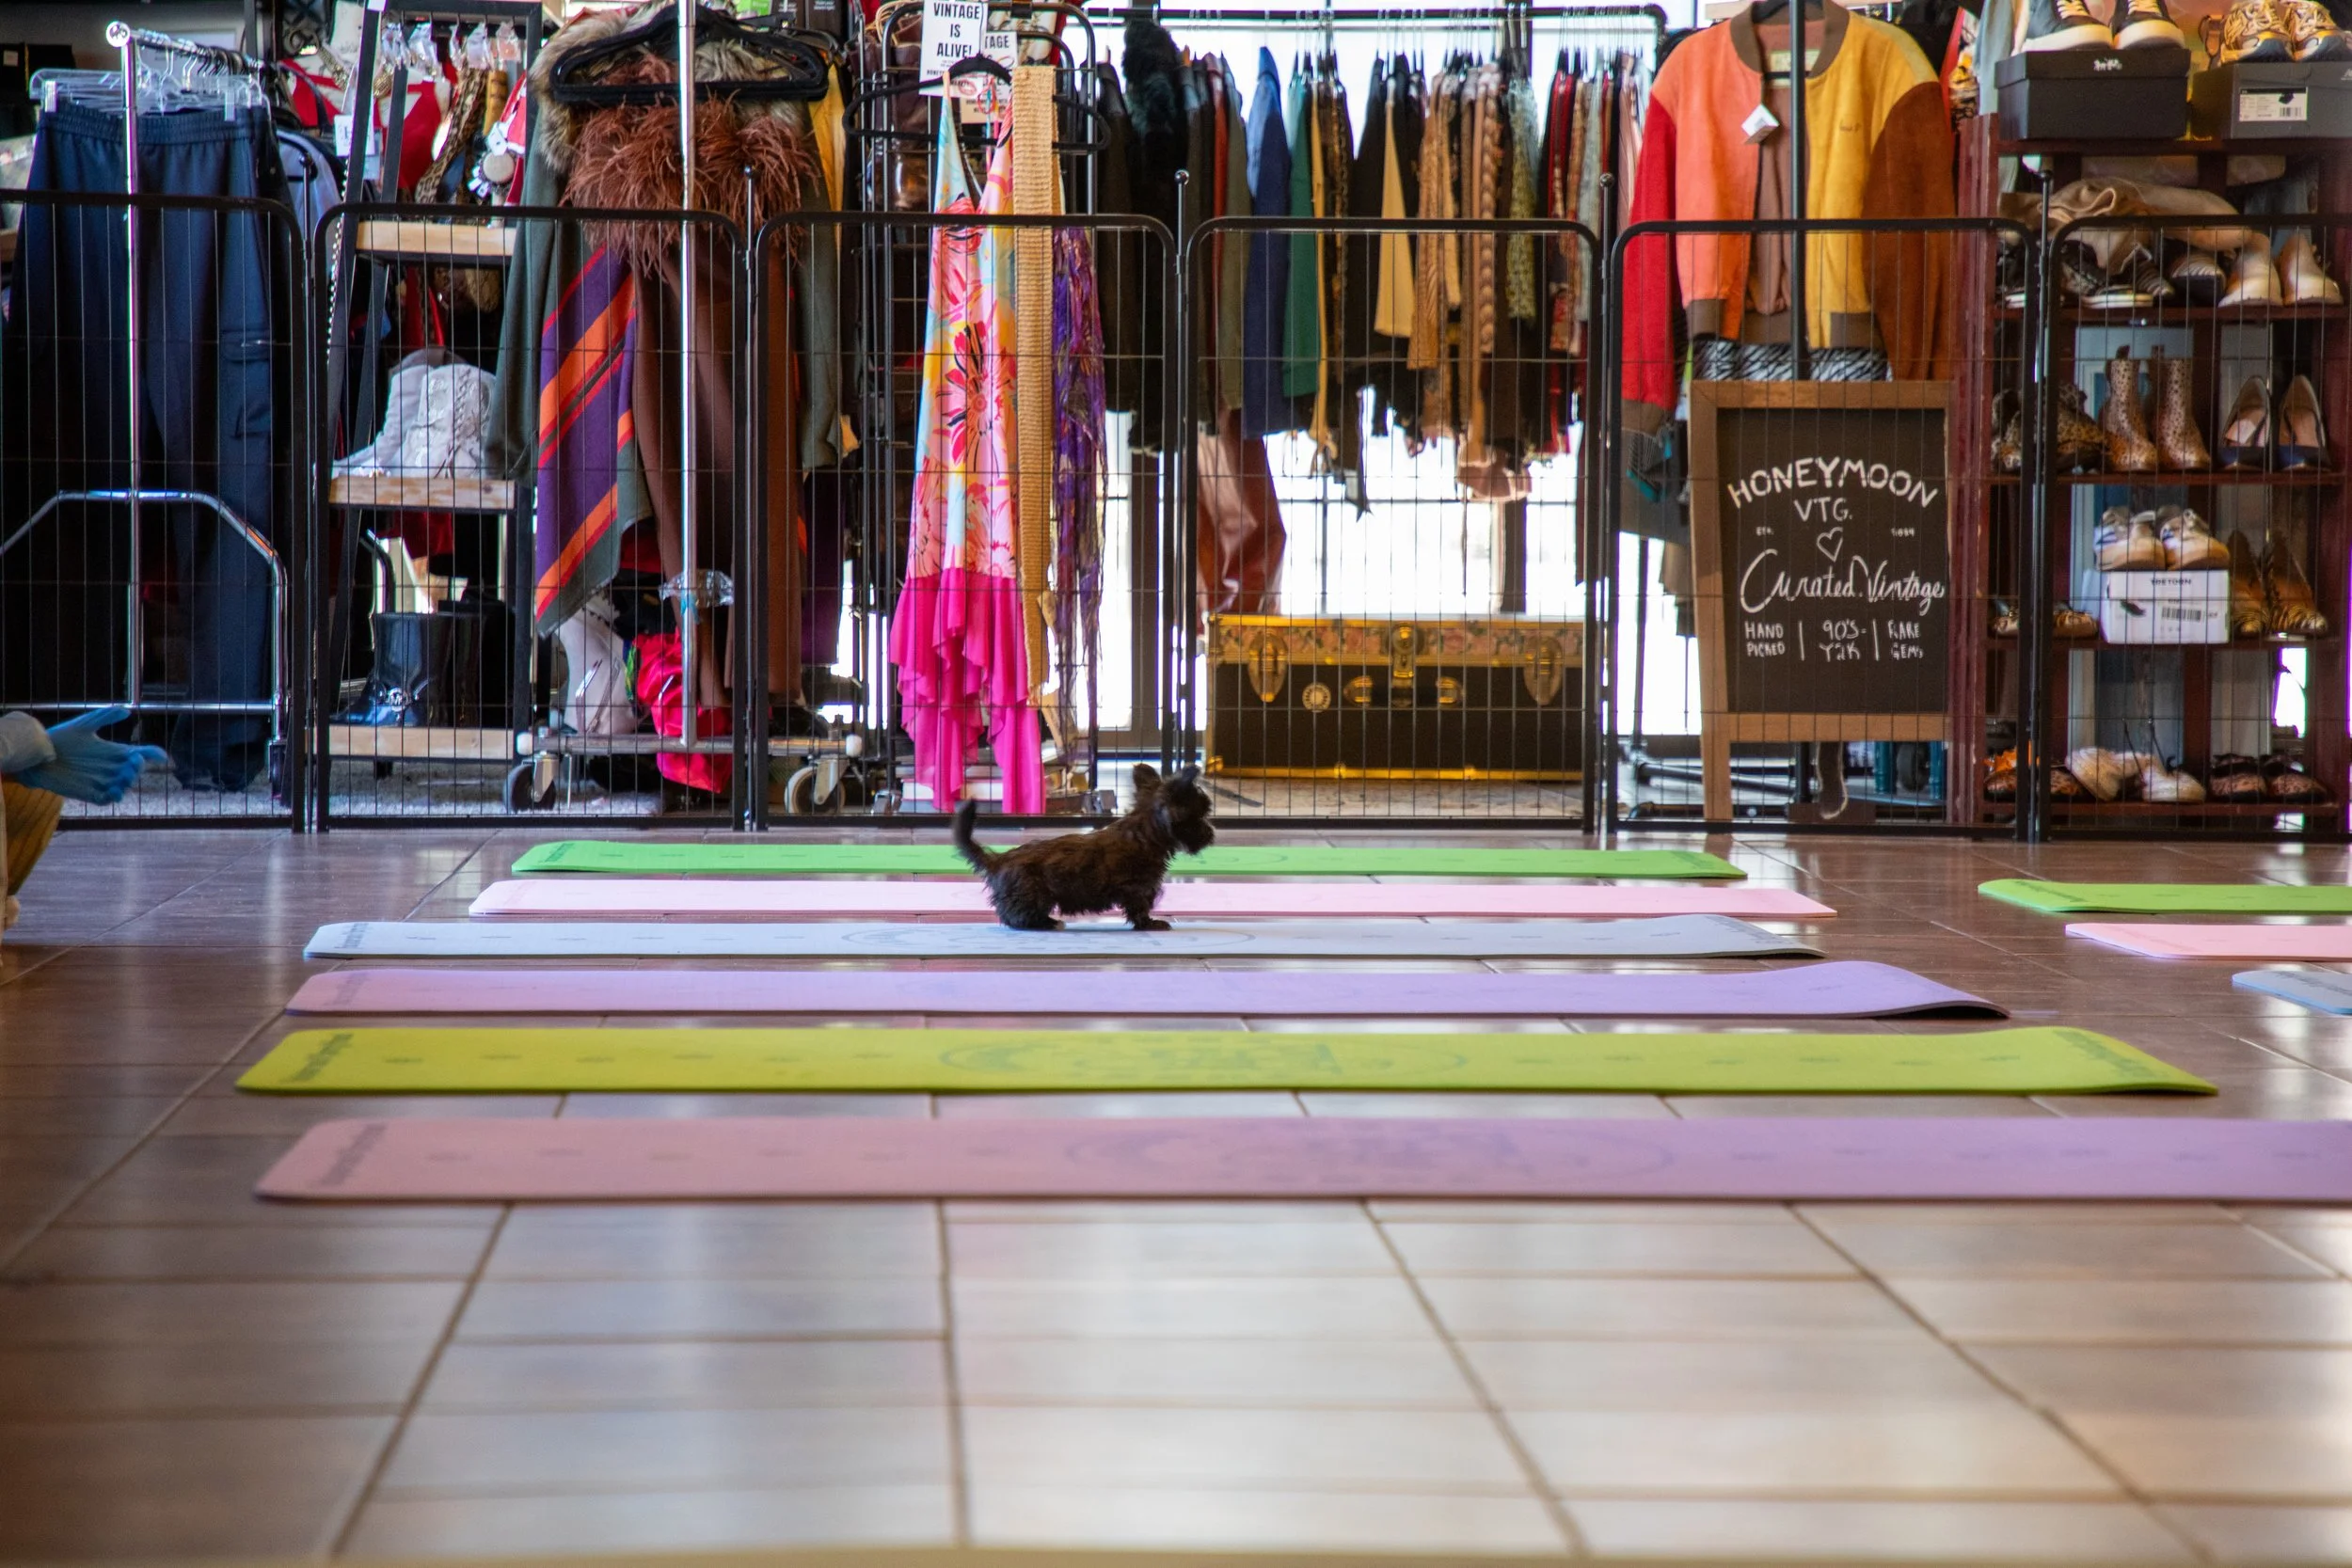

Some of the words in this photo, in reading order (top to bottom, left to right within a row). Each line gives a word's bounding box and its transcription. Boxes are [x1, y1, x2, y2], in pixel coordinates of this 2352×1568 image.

[933, 2, 980, 20] VINTAGE
[949, 24, 961, 38] IS
[936, 42, 972, 57] ALIVE!
[984, 35, 1009, 49] TAGE
[1727, 456, 1938, 509] HONEYMOON
[1740, 548, 1858, 613] Curated
[1857, 556, 1946, 616] Vintage
[1745, 621, 1784, 640] HAND
[1887, 620, 1920, 640] RARE
[1747, 641, 1786, 657] PICKED
[1819, 641, 1860, 662] Y2K
